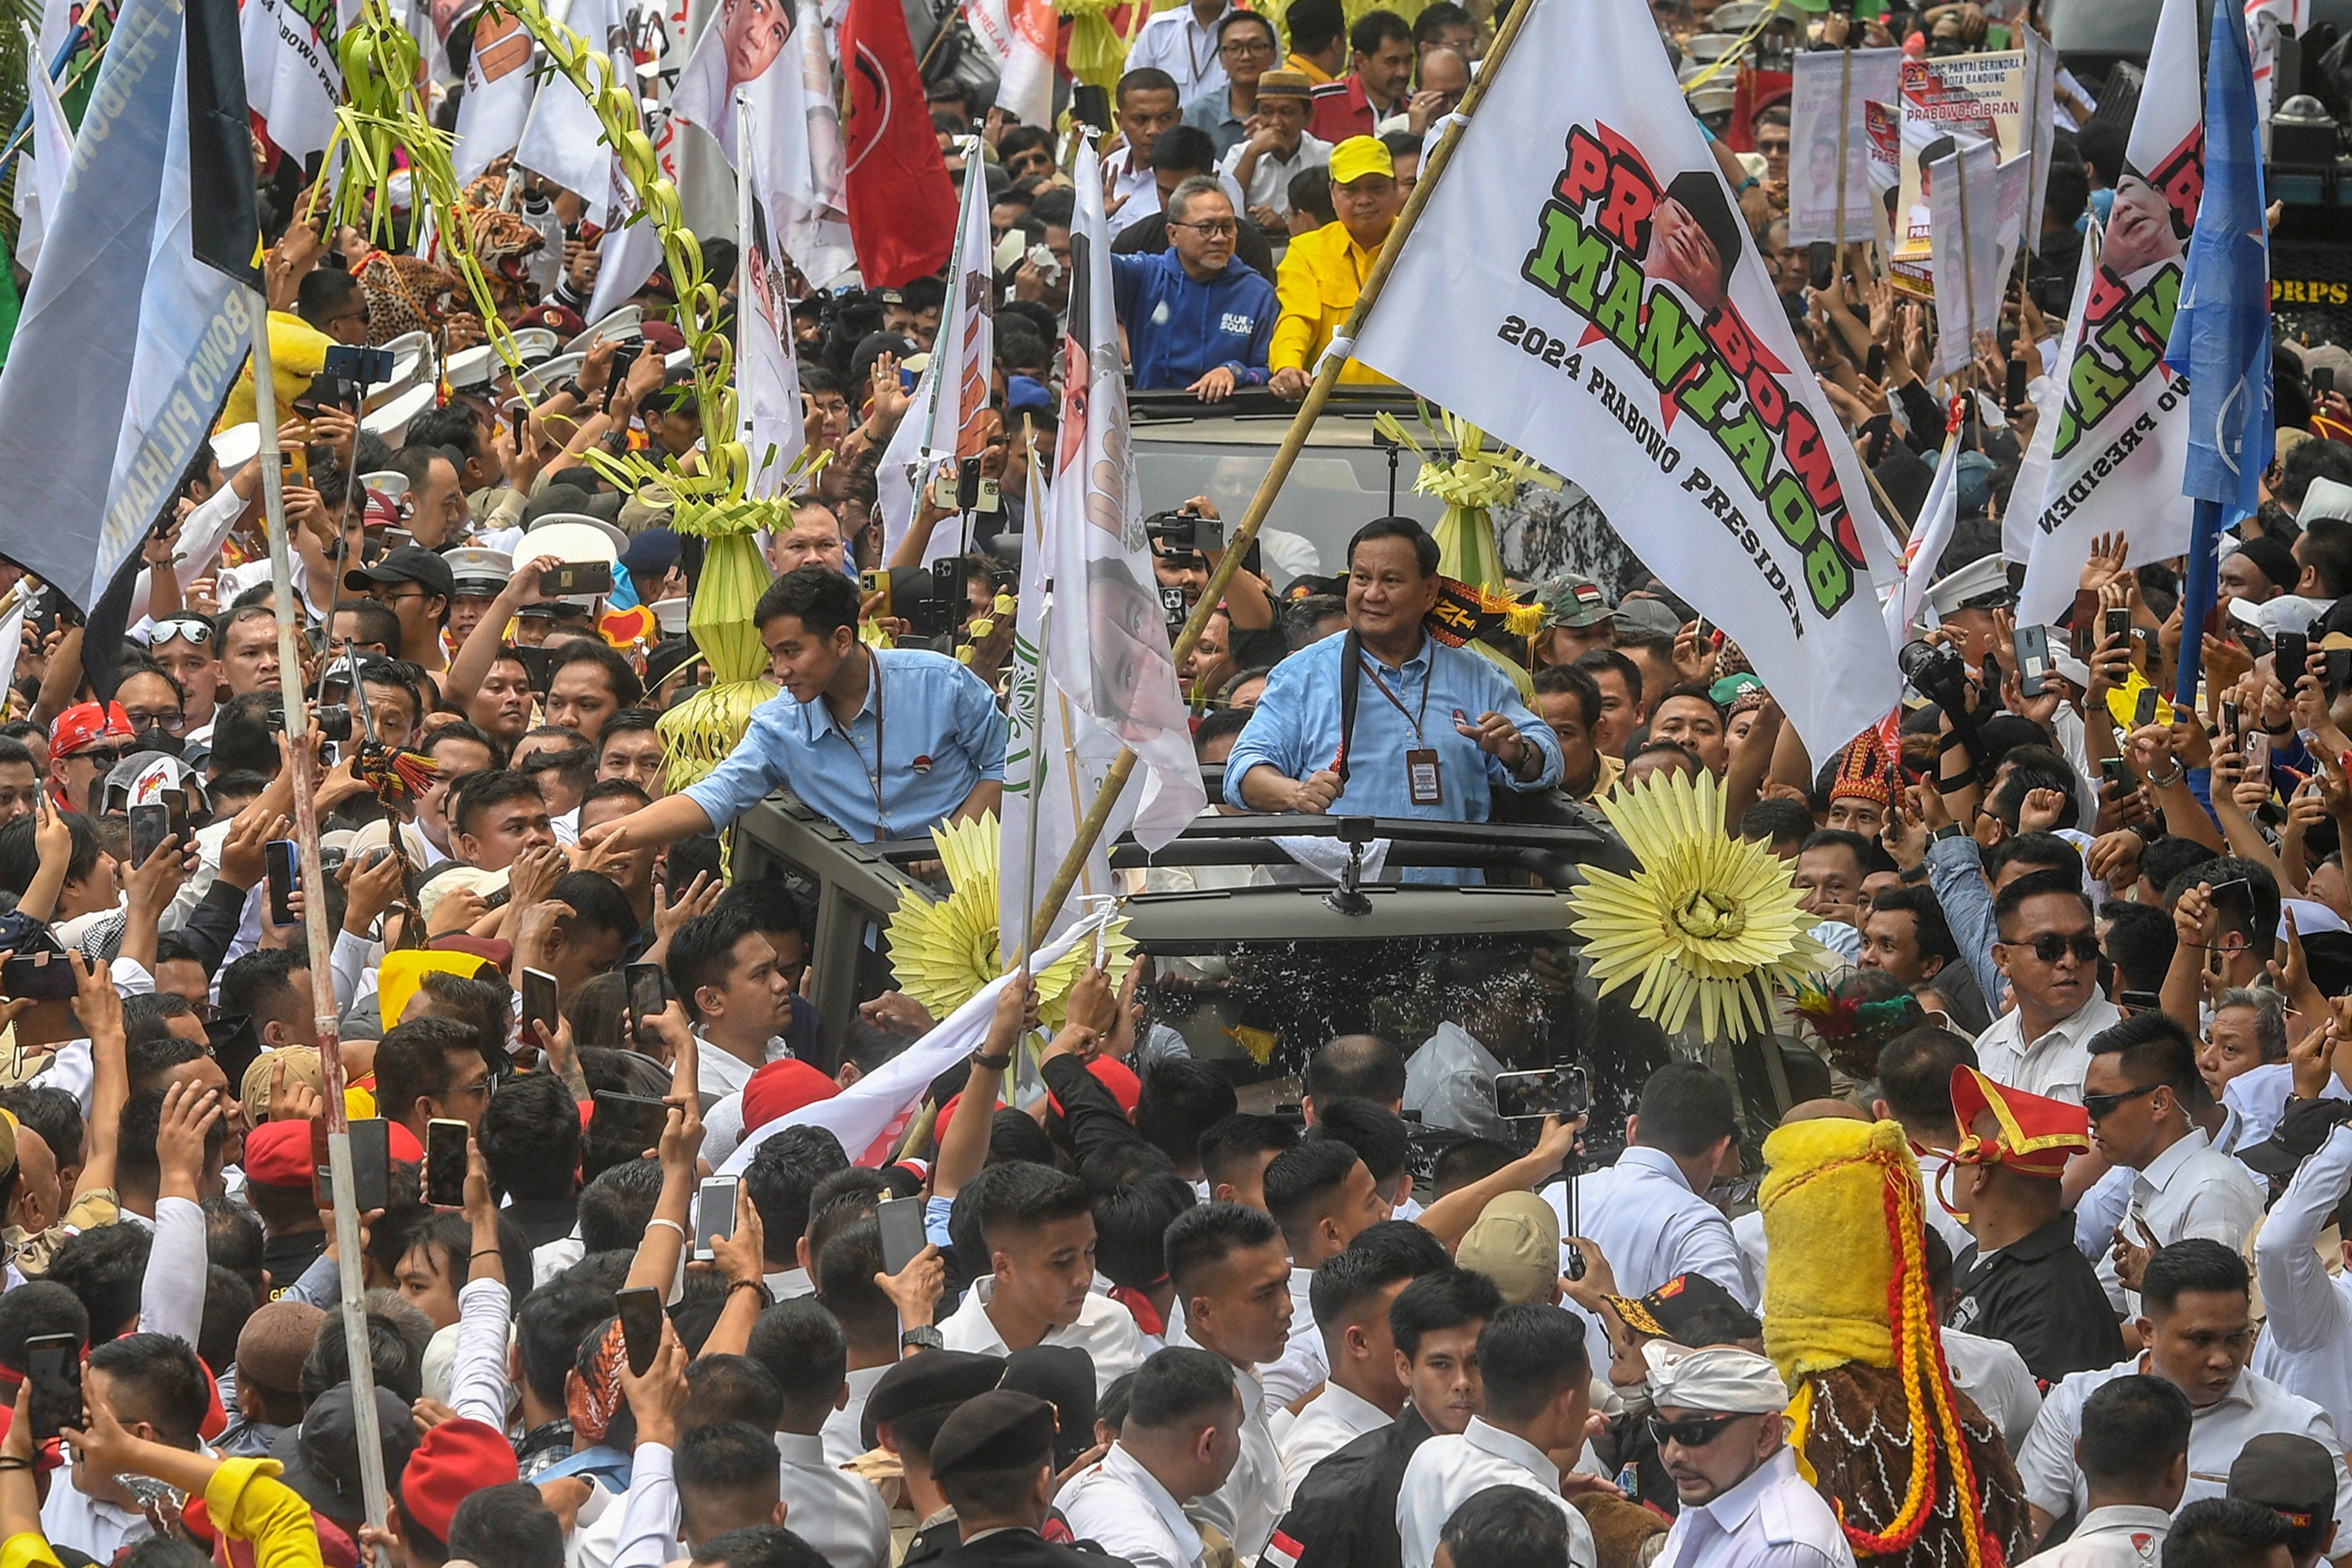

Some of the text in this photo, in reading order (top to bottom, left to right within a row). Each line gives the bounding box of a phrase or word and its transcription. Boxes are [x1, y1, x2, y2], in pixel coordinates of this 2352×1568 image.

[1949, 61, 1977, 73] PARTAI
[1979, 58, 2020, 71] GERINDRA
[1944, 72, 2006, 86] KOTA BANDUNG
[1497, 316, 1805, 641] 2024 PRABOWO PRESIDEN
